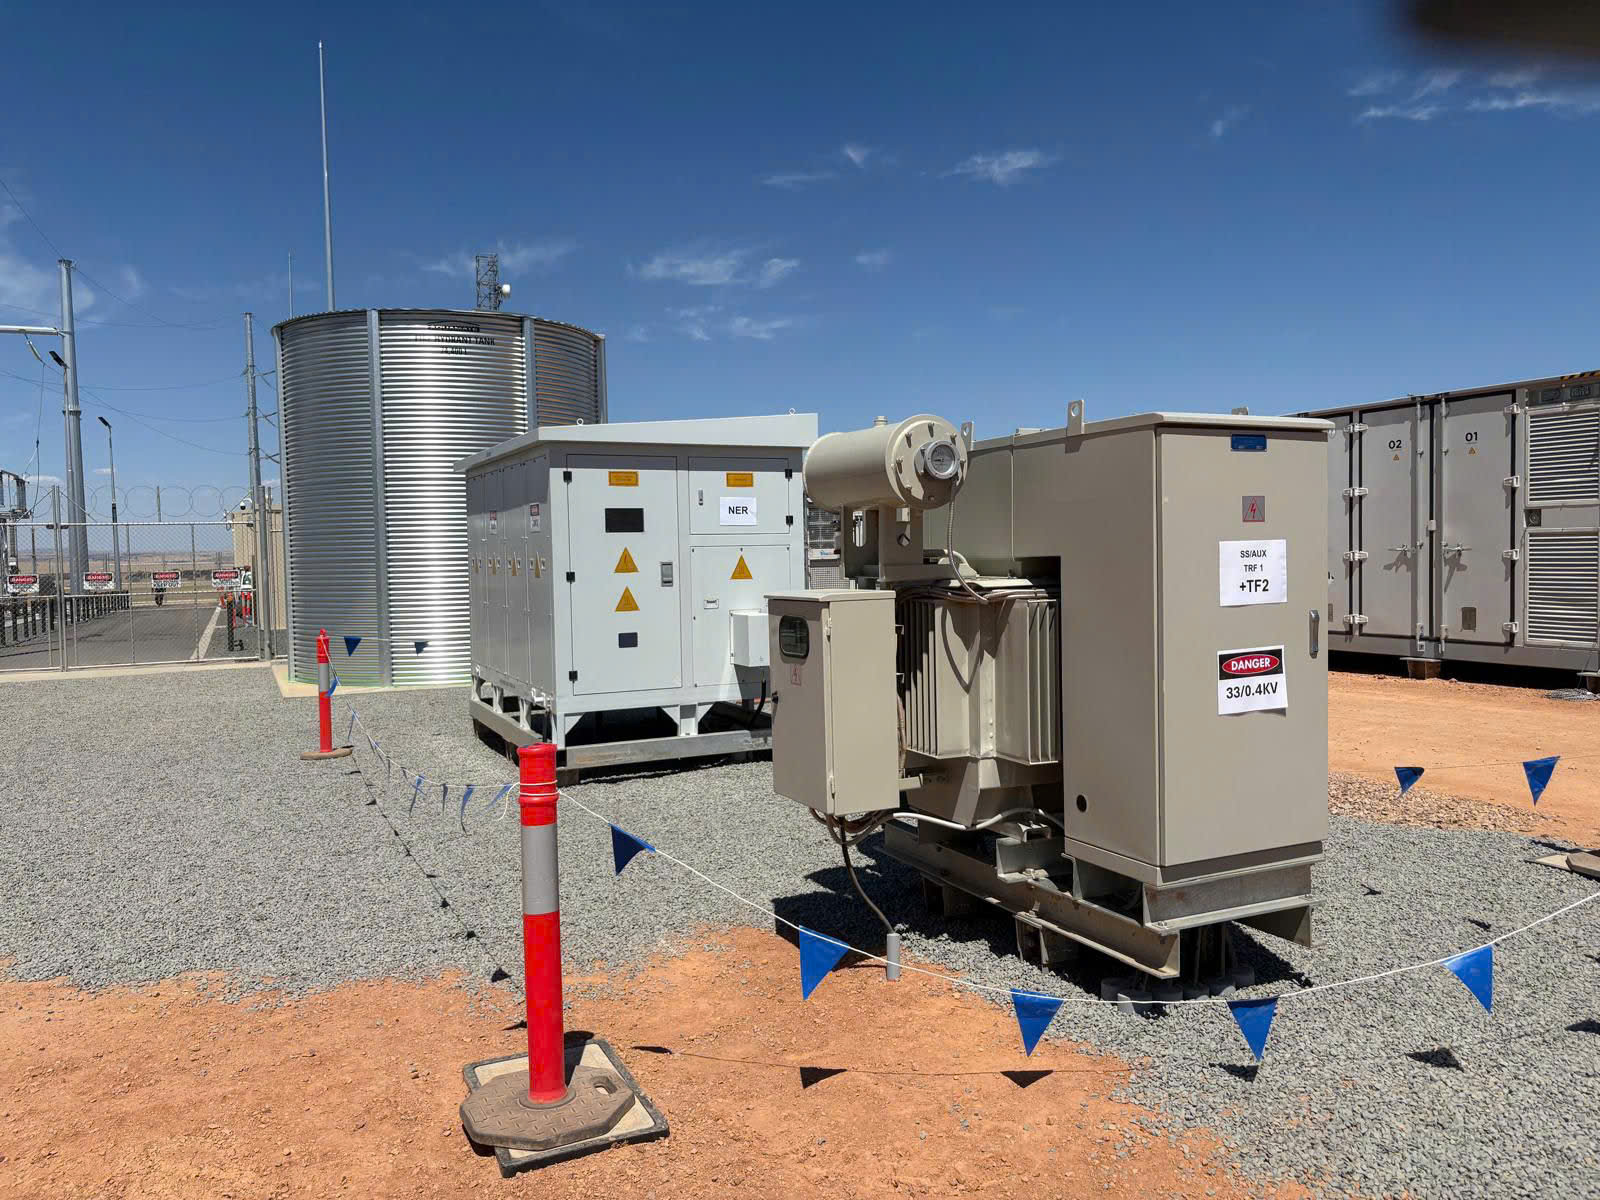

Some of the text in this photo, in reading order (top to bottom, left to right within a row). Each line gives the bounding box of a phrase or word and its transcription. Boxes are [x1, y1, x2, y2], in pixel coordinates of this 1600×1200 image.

[475, 336, 496, 346] TANK
[1465, 432, 1478, 442] 01
[1388, 440, 1402, 449] 02
[728, 506, 748, 515] NER
[1240, 549, 1267, 559] SS/AUX
[1243, 563, 1264, 572] TRF 1
[1240, 579, 1269, 592] +TF2
[1231, 657, 1271, 671] DANGER
[1226, 681, 1278, 699] 33/0.4KV
